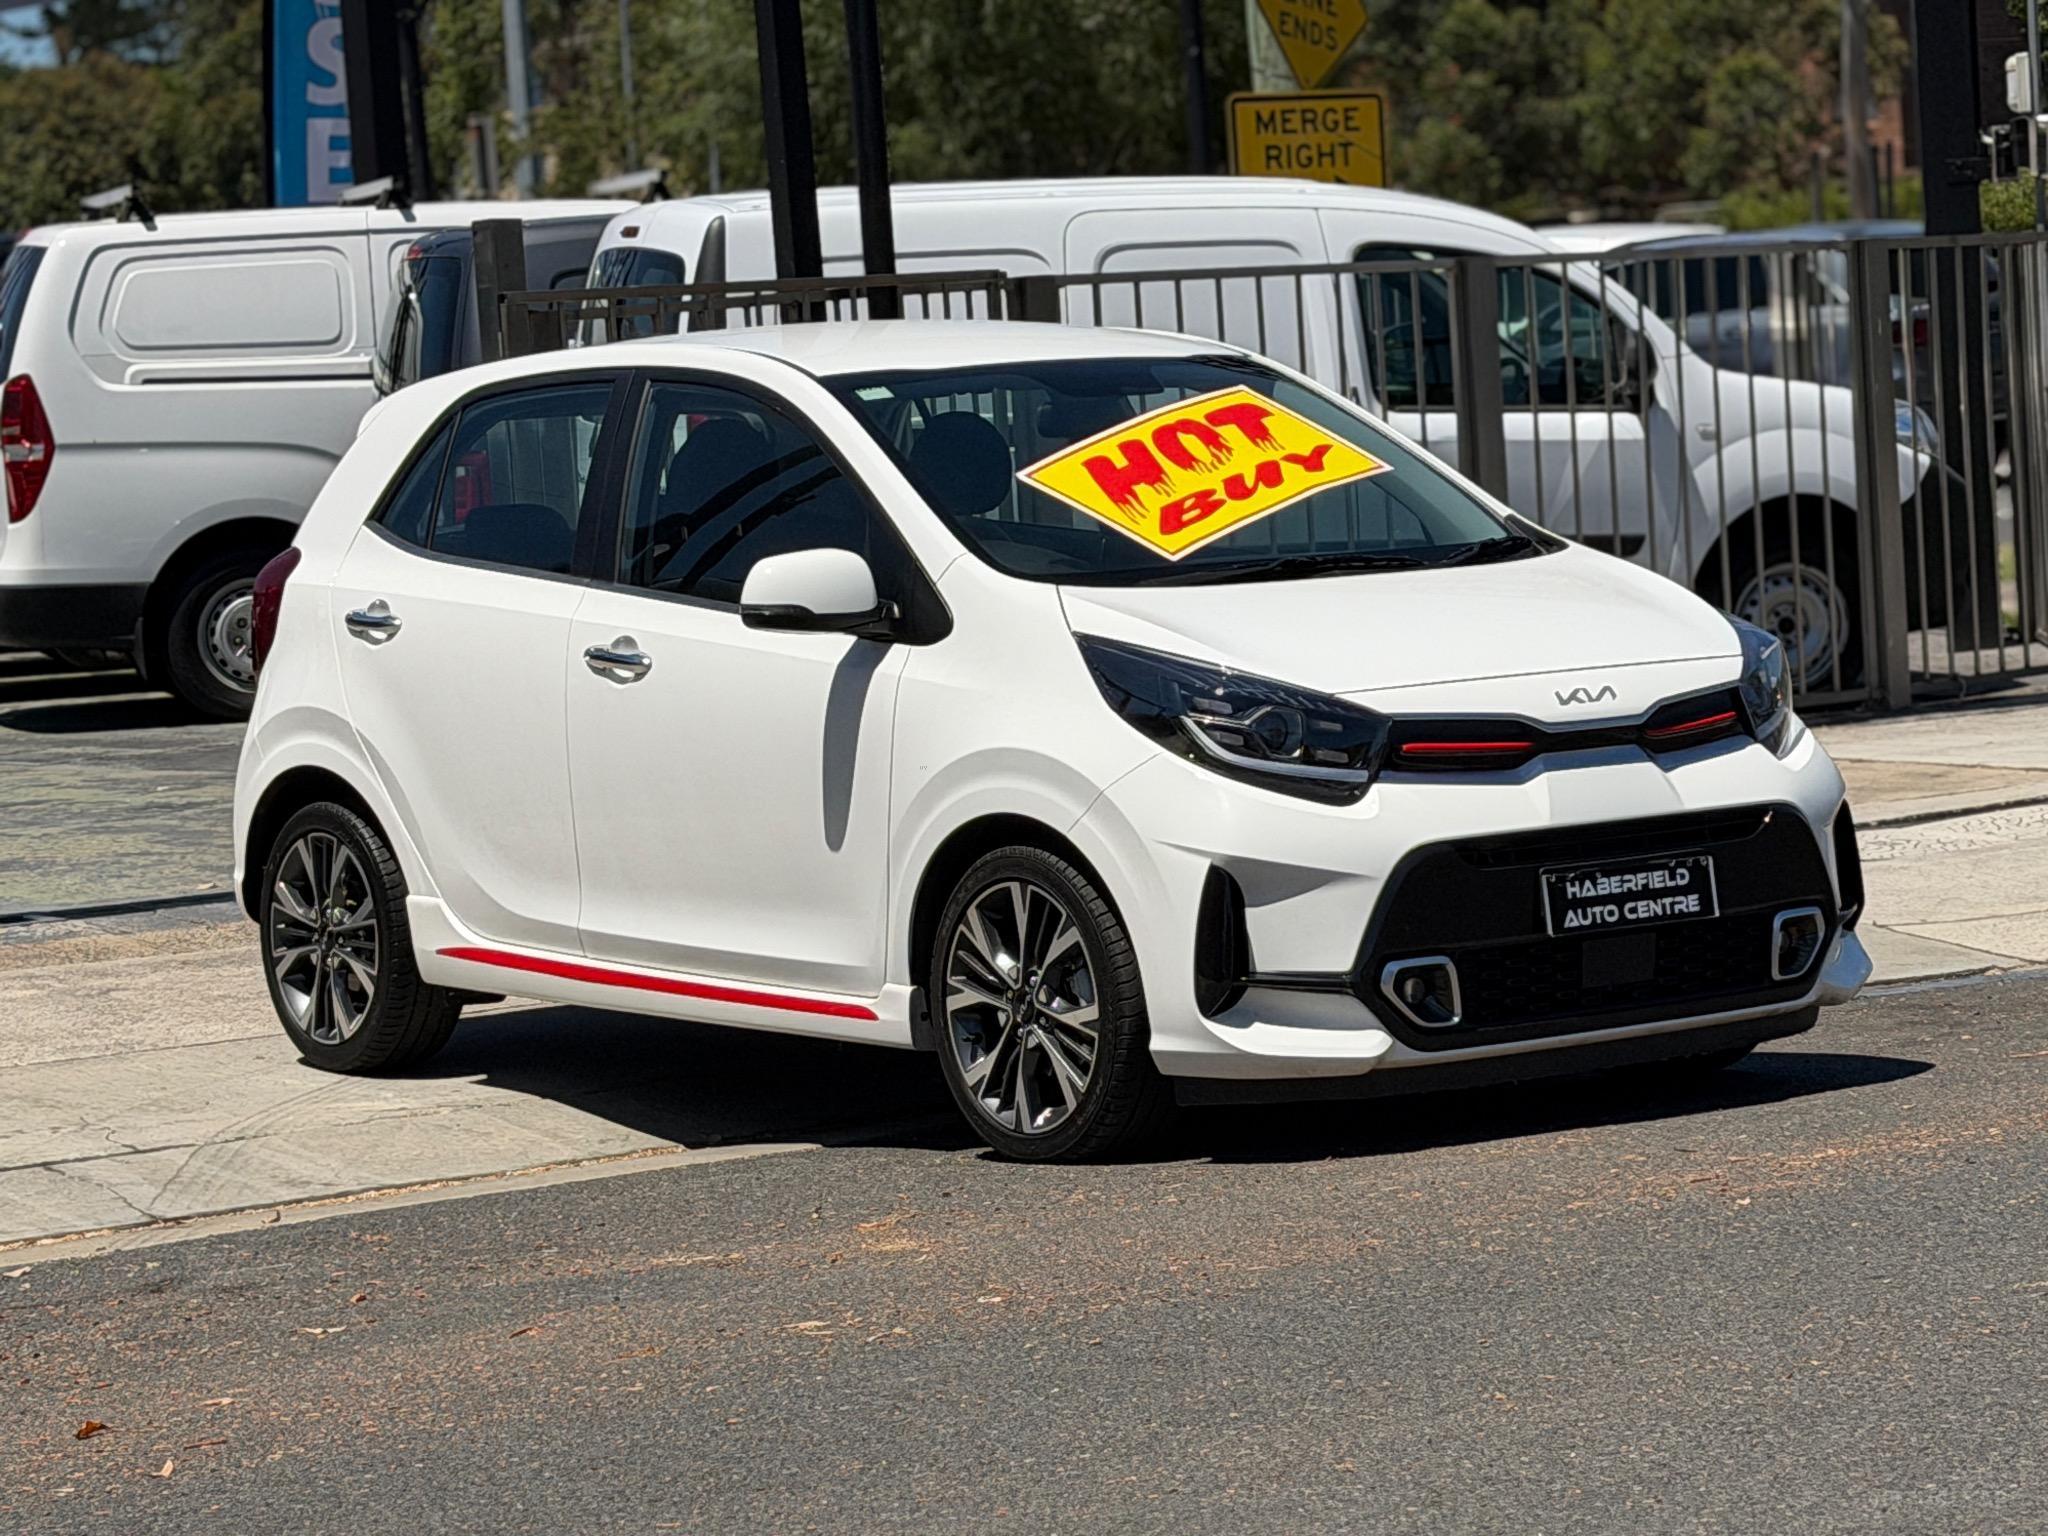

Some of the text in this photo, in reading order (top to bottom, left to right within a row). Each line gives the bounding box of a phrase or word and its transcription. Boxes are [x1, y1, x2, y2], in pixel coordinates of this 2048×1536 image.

[1279, 10, 1337, 51] ENDS
[1255, 107, 1360, 135] MERGE
[1265, 142, 1352, 170] RIGHT
[1081, 403, 1282, 525] HOT
[1159, 444, 1334, 535] BUY
[1555, 685, 1617, 706] KIA
[1566, 868, 1690, 899] HABERFIELD
[1564, 894, 1700, 928] AUTO CENTRE
